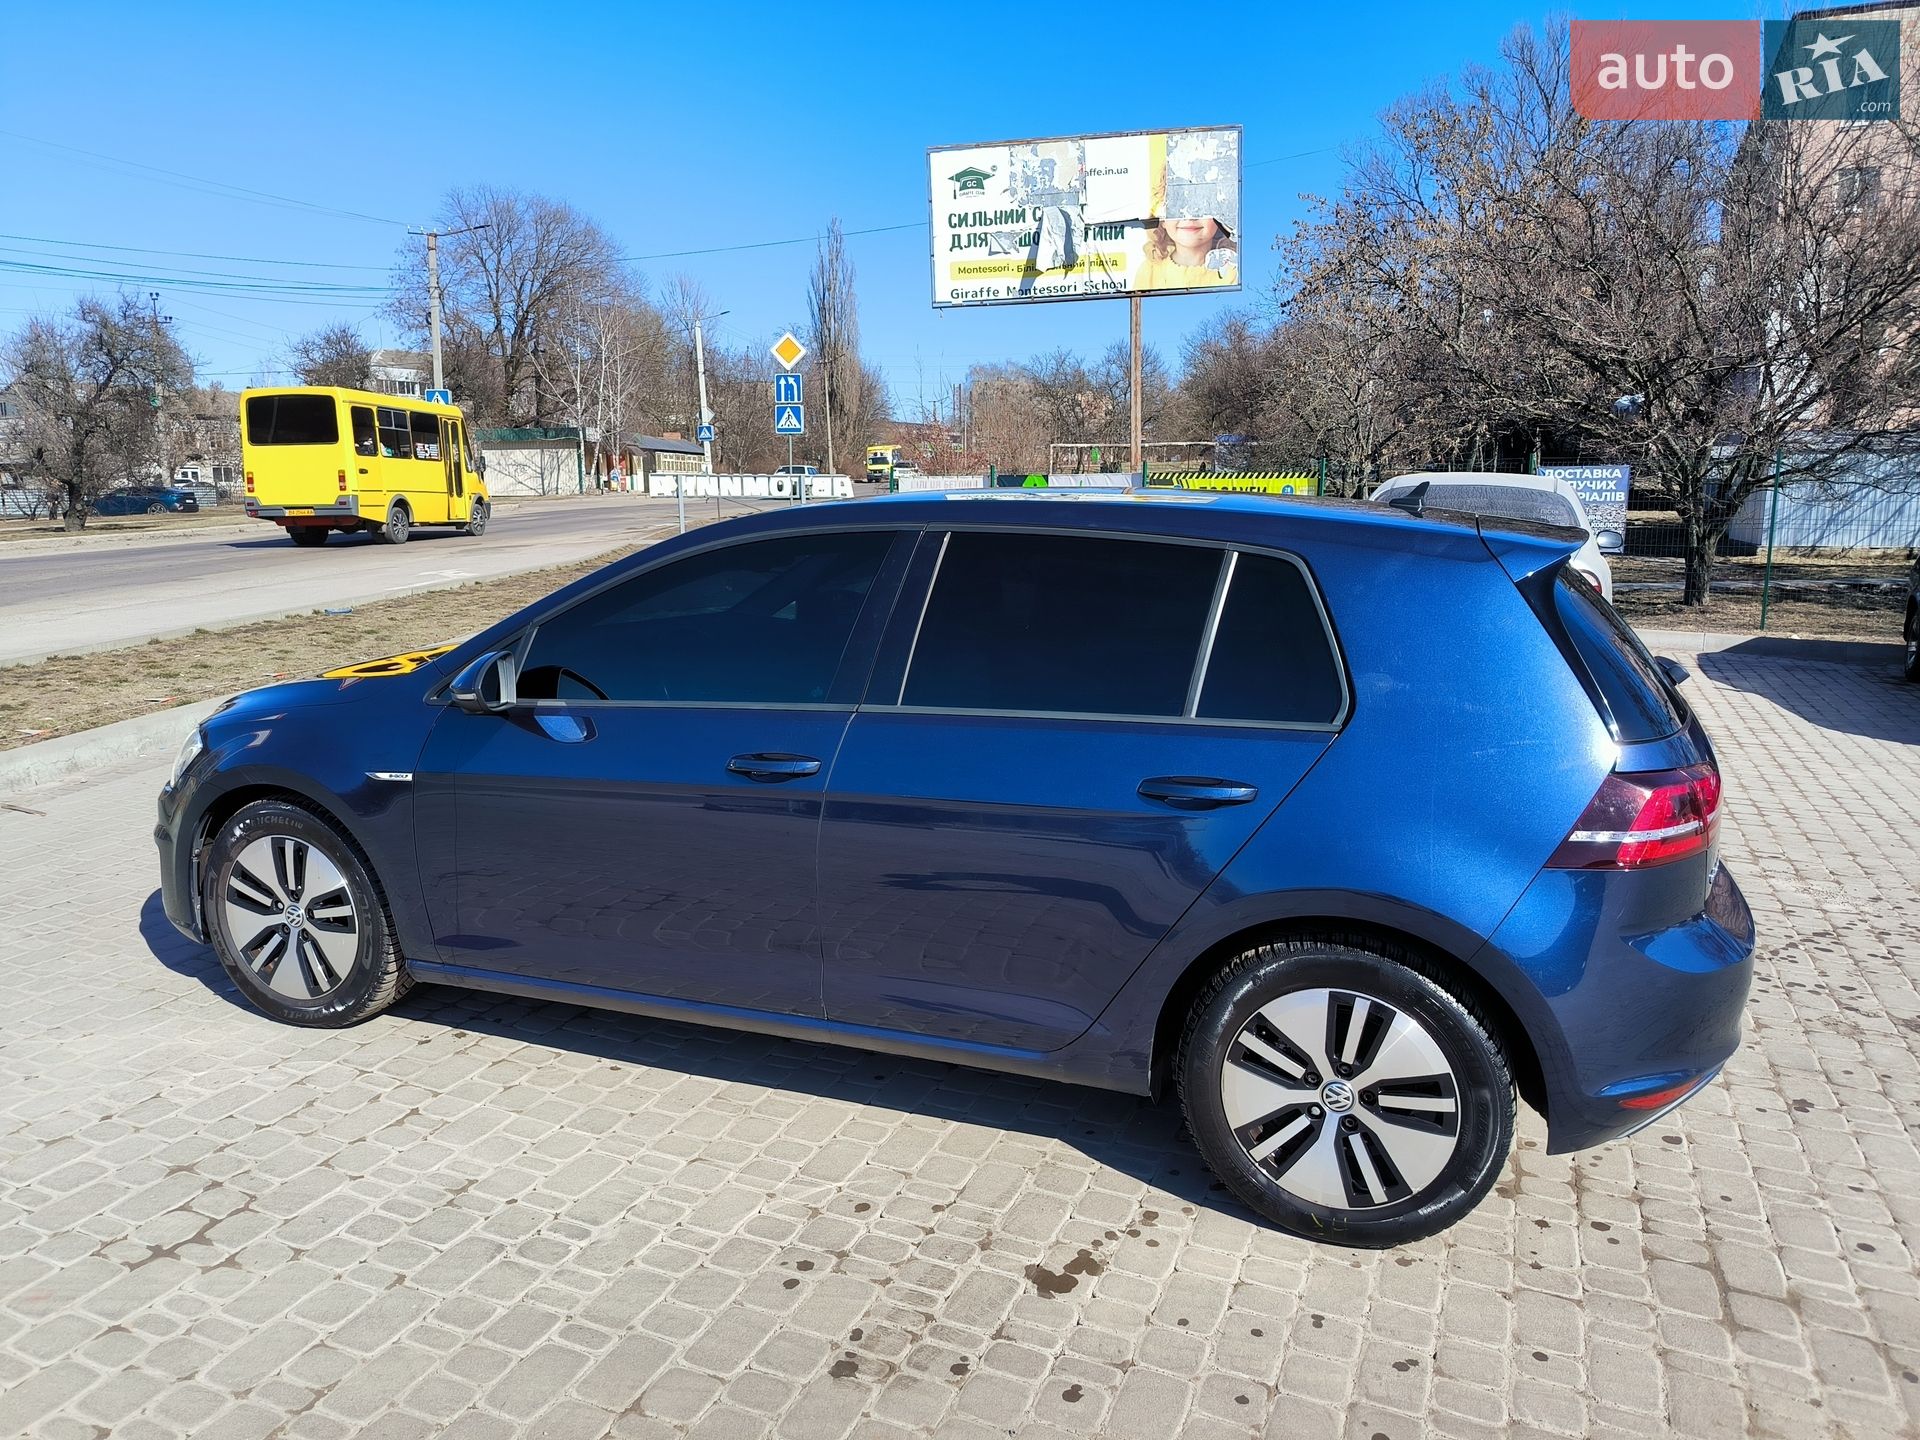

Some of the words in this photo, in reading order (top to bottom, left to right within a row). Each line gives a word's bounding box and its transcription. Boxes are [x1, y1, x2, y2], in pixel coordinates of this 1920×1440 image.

[948, 205, 1026, 229] СИЛЬНИЙ
[949, 231, 989, 252] ДЛЯ
[1090, 257, 1118, 268] підід
[958, 263, 1010, 275] Montessori
[950, 286, 1000, 300] Giraffe
[1006, 281, 1077, 297] Montessori
[1084, 278, 1127, 292] School
[1545, 468, 1622, 479] ДОСТАВКА
[1568, 480, 1617, 491] ПУЧИХ
[1579, 491, 1625, 502] РІАЛІВ
